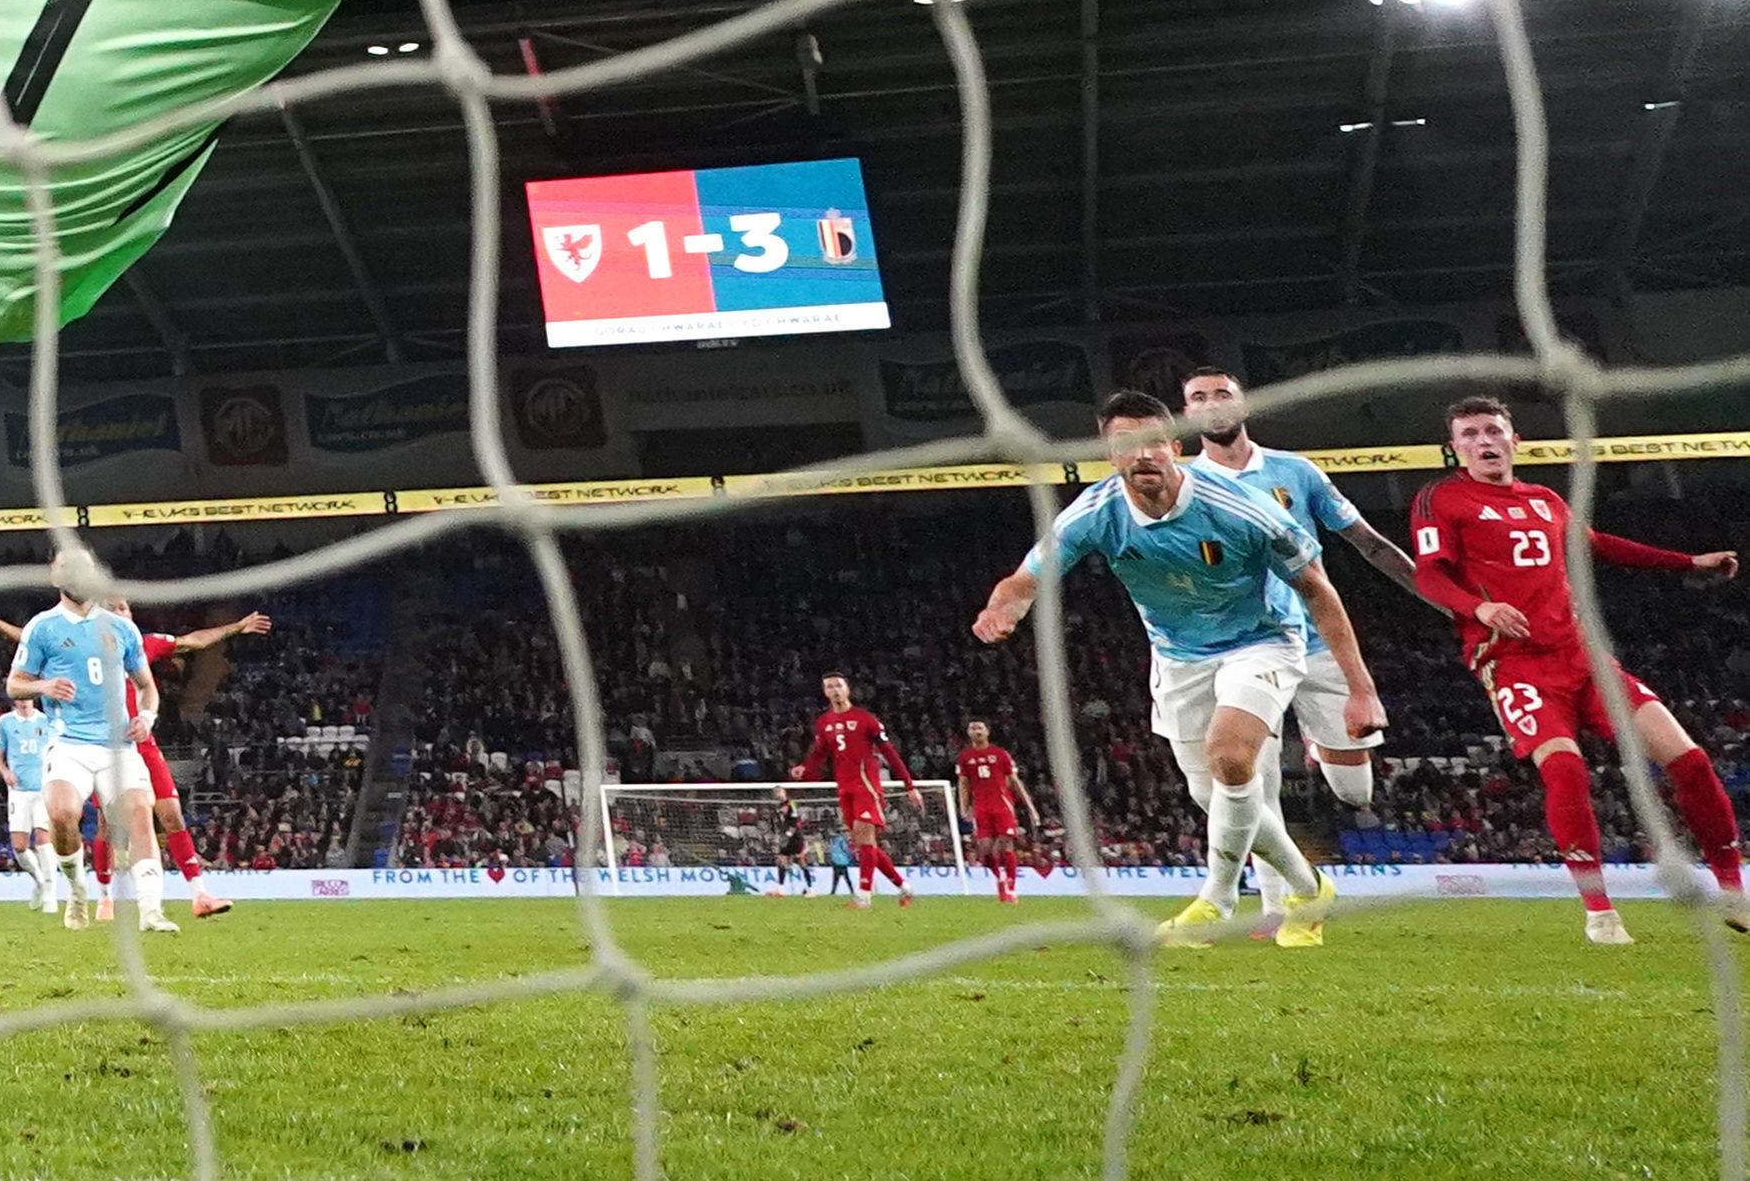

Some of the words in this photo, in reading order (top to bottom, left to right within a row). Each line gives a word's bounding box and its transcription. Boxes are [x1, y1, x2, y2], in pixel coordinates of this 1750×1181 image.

[918, 469, 1029, 485] NETWORK
[576, 484, 681, 499] NETWORK
[203, 504, 258, 516] BEST
[259, 500, 356, 513] NETWORK
[1509, 530, 1551, 567] 23
[87, 657, 103, 685] 8
[1498, 682, 1544, 723] 23
[836, 734, 846, 751] 5
[373, 869, 432, 884] FROM
[441, 869, 480, 884] THE
[514, 869, 539, 884] OF
[597, 868, 670, 884] WELSH
[681, 868, 817, 884] MOUNTANS
